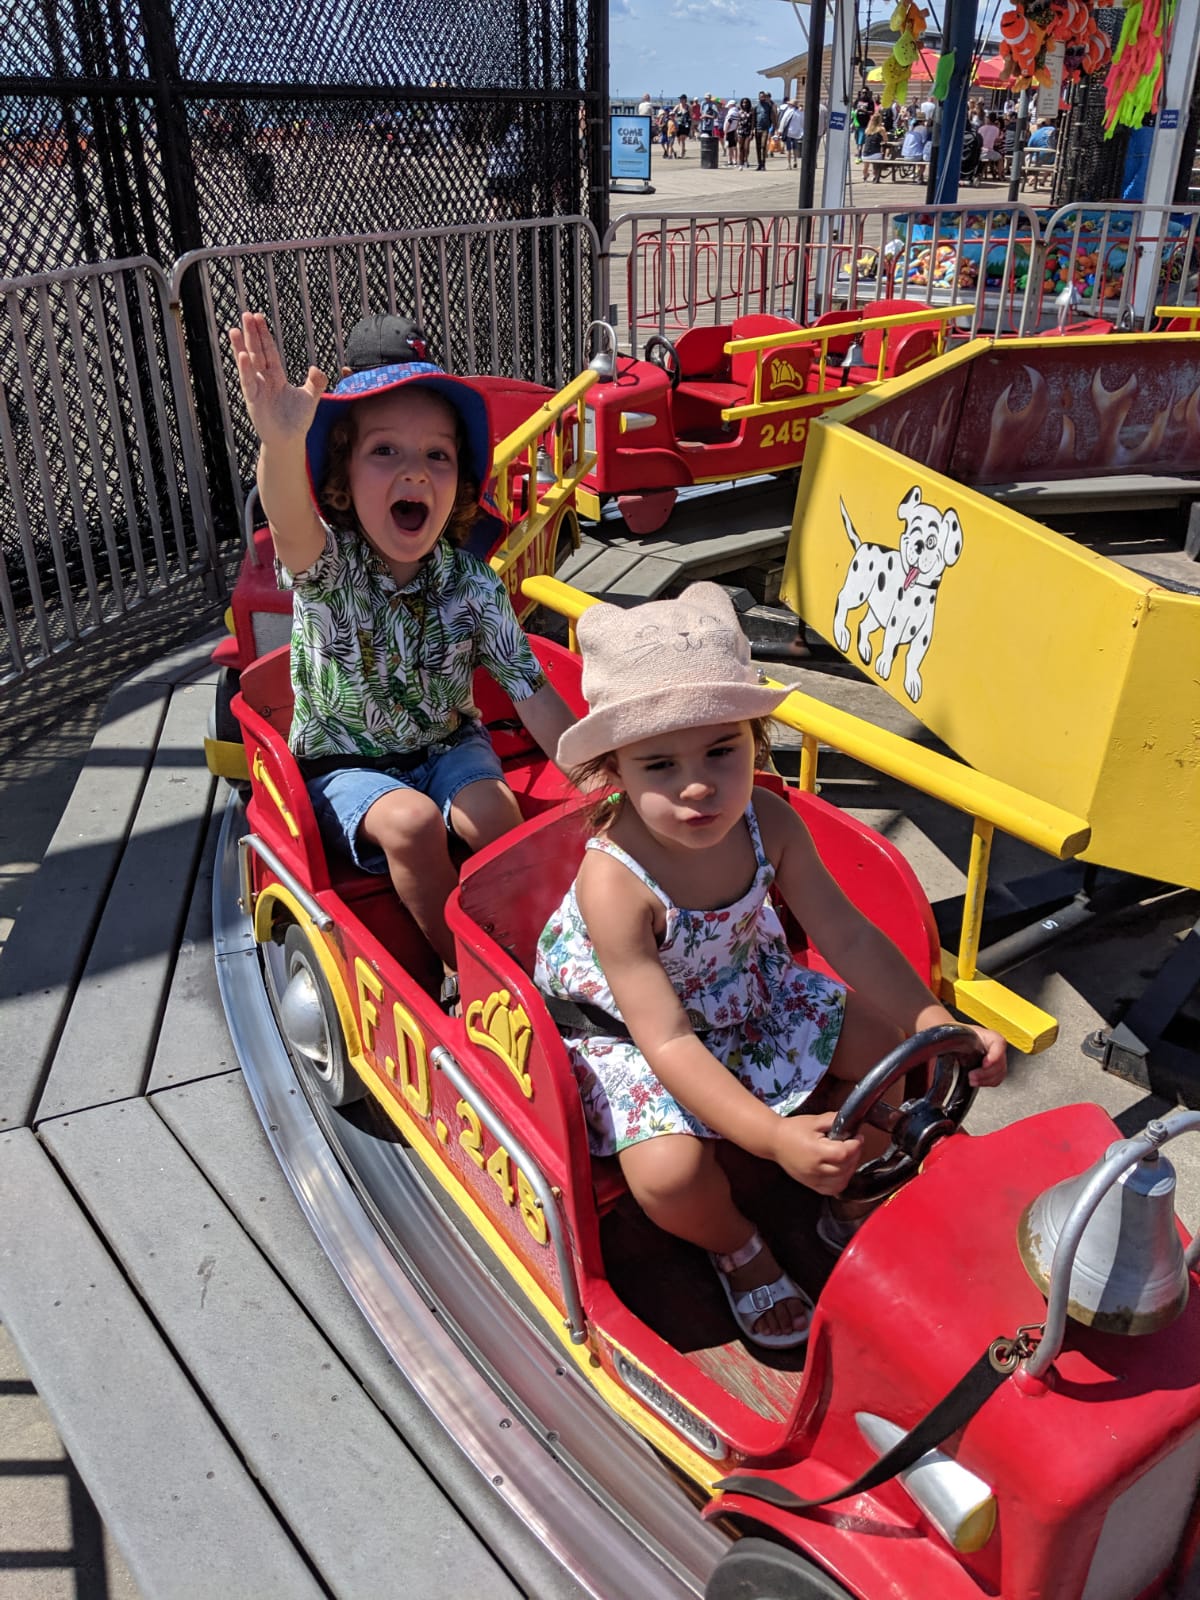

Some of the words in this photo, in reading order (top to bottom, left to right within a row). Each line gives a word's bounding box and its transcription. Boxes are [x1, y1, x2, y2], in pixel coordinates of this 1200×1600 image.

[617, 127, 643, 136] COME
[621, 136, 640, 145] SEA
[760, 418, 807, 448] 245
